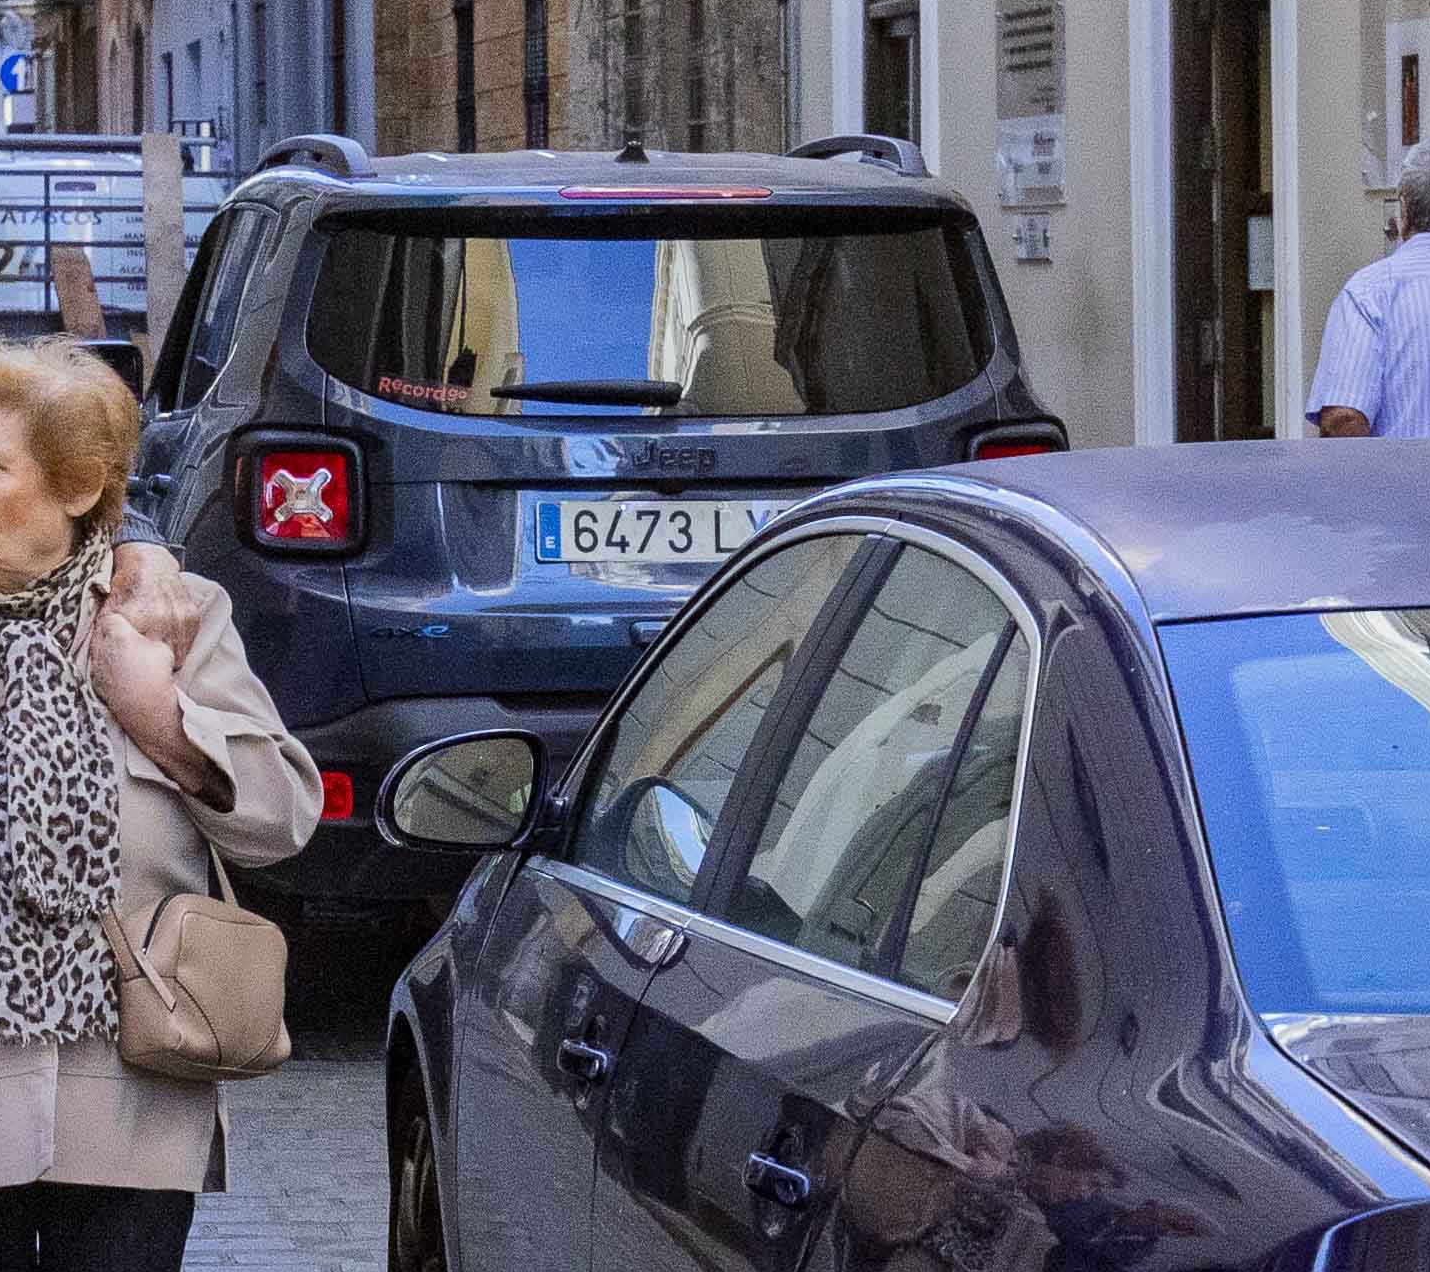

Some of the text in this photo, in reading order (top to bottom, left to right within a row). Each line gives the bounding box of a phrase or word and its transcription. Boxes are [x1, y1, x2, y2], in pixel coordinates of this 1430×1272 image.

[633, 438, 717, 474] Jeep
[545, 535, 556, 548] E
[573, 509, 693, 555] 6473
